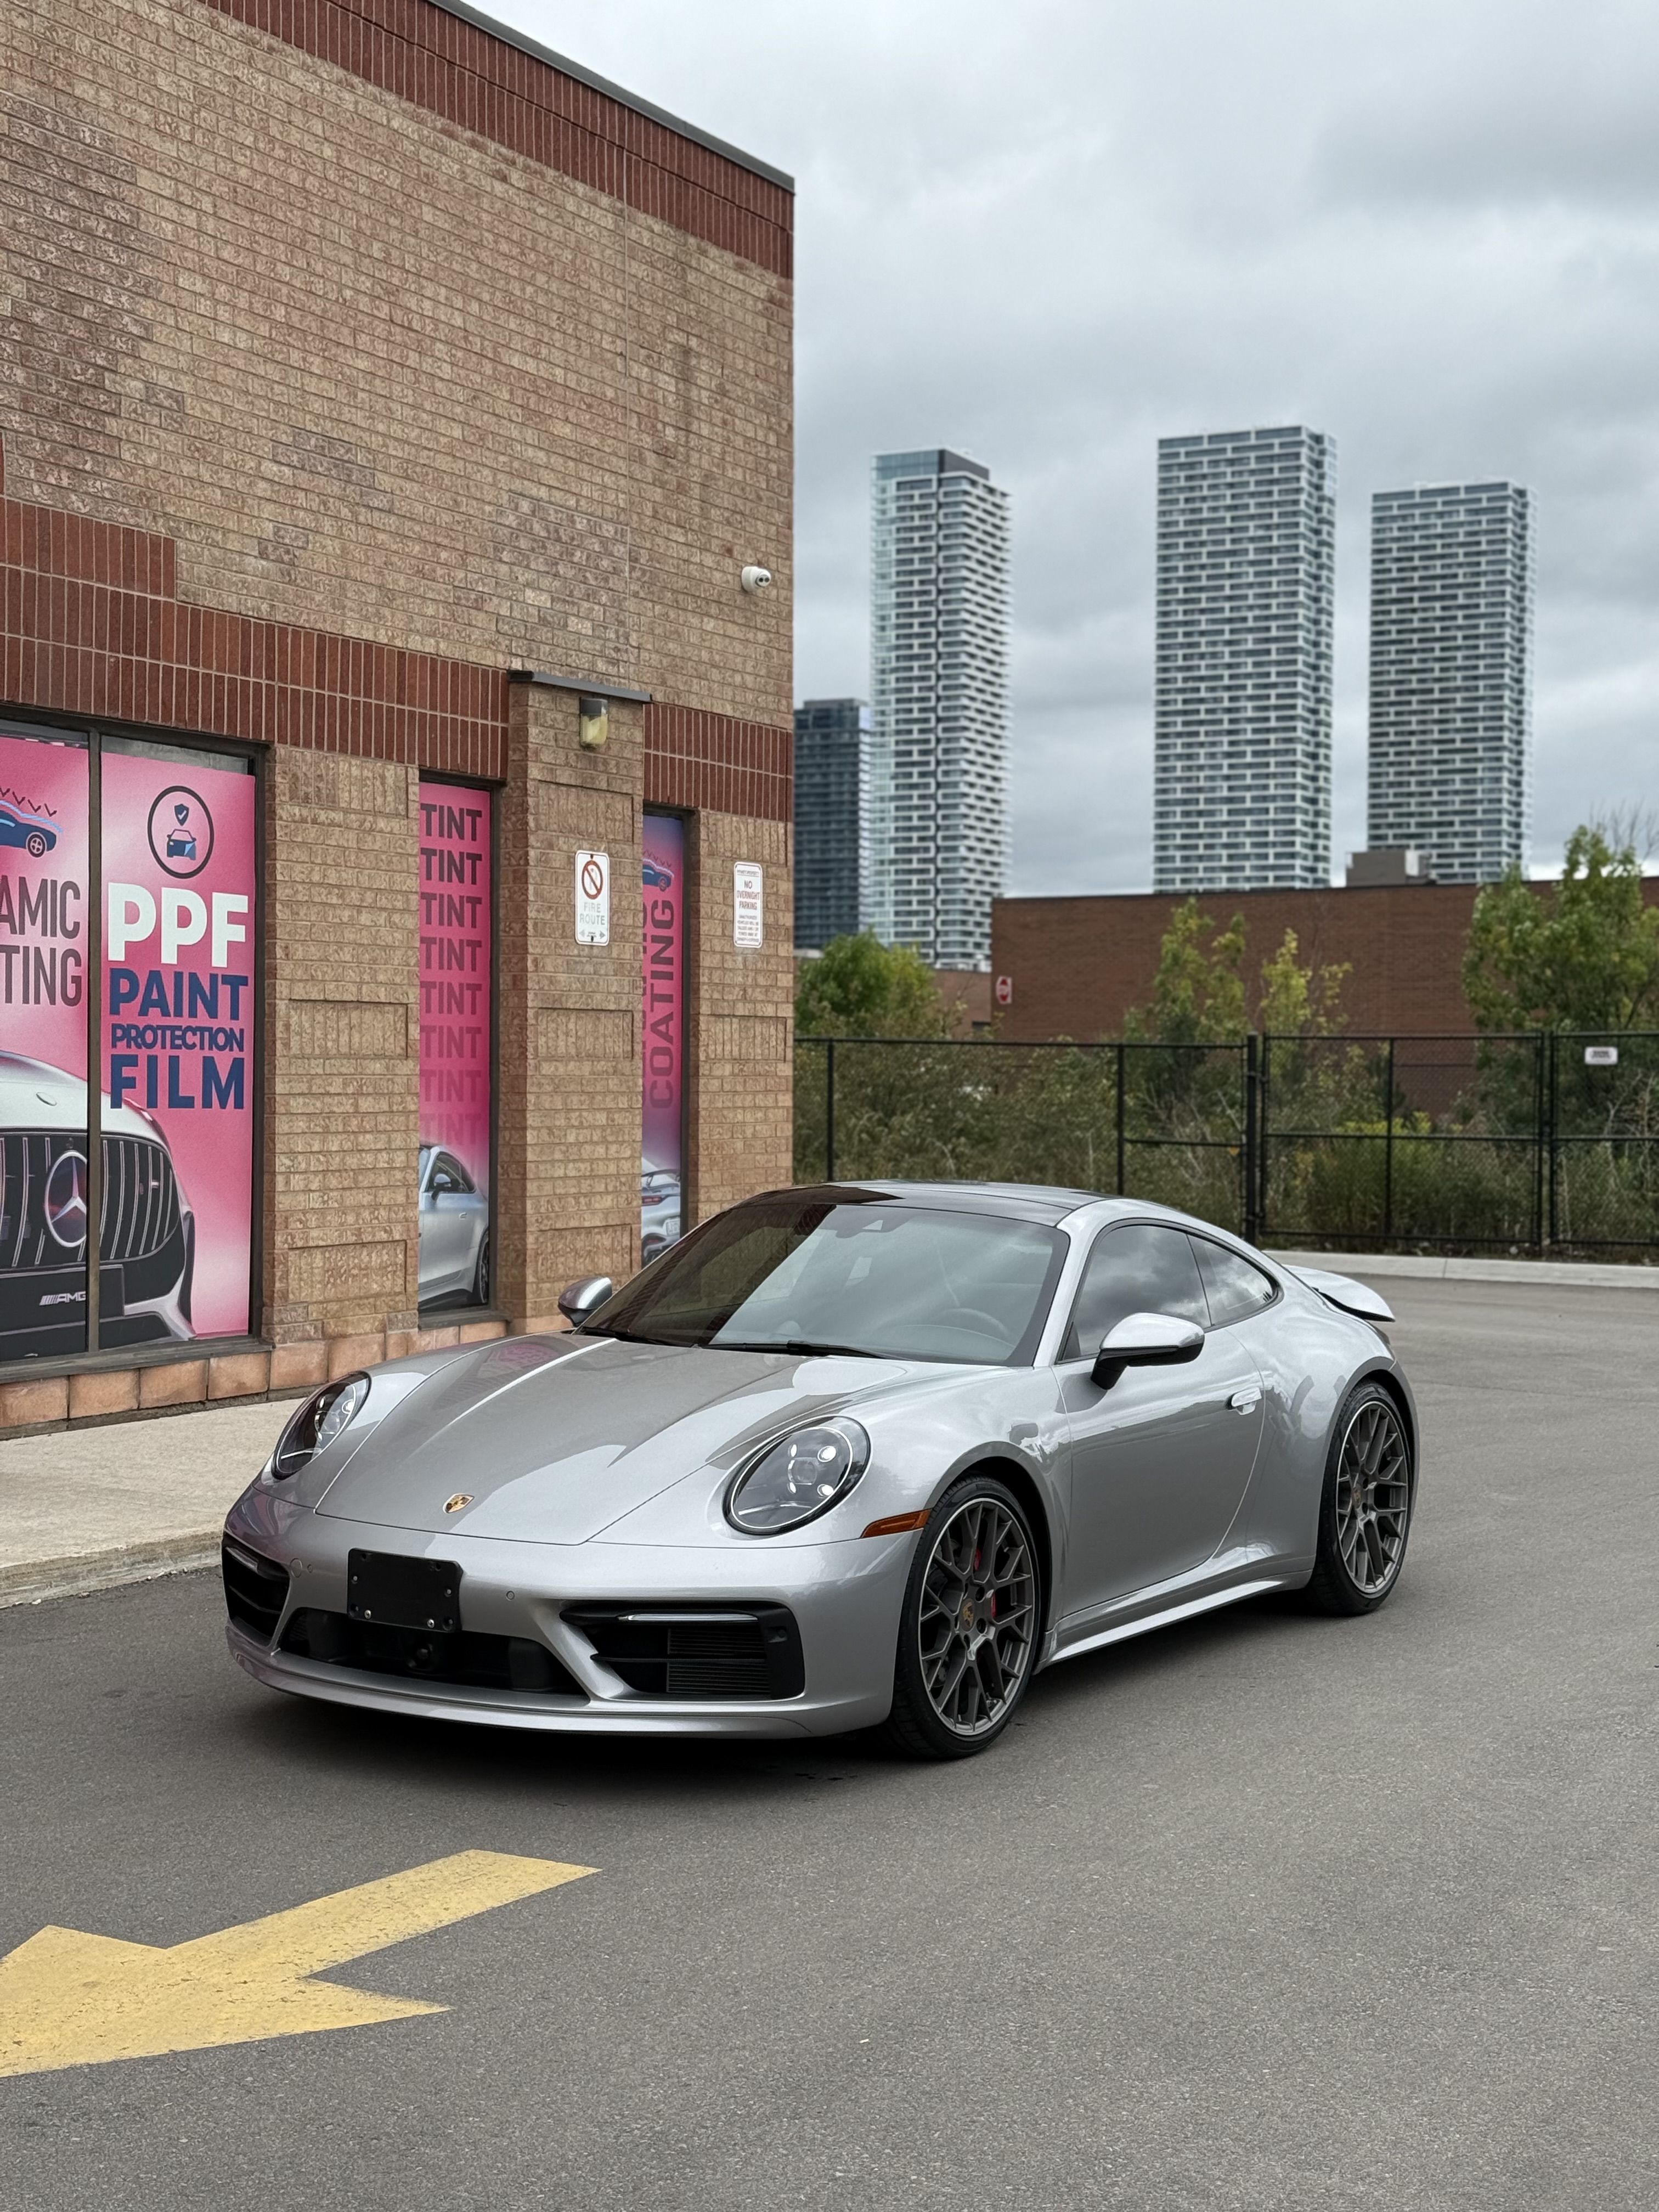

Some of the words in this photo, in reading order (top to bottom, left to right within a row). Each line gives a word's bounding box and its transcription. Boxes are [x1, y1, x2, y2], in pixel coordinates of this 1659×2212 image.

[420, 803, 483, 842] TINT
[420, 848, 483, 885] TINT
[744, 880, 753, 889] NO
[0, 874, 81, 939] AMIC
[420, 892, 482, 929] TINT
[579, 913, 606, 926] ROUTE
[584, 902, 601, 913] FIRE
[108, 882, 249, 968] PPF
[420, 936, 482, 972] TINT
[0, 944, 82, 1007] TING
[110, 968, 249, 1022] PAINT
[420, 981, 482, 1015] TINT
[649, 899, 674, 1109] COATING
[111, 1024, 245, 1052] PROTECTION
[420, 1025, 482, 1059] TINT
[110, 1054, 245, 1110] FILM
[420, 1070, 482, 1102] TINT
[420, 1113, 482, 1146] TINT
[57, 1291, 86, 1304] AMG
